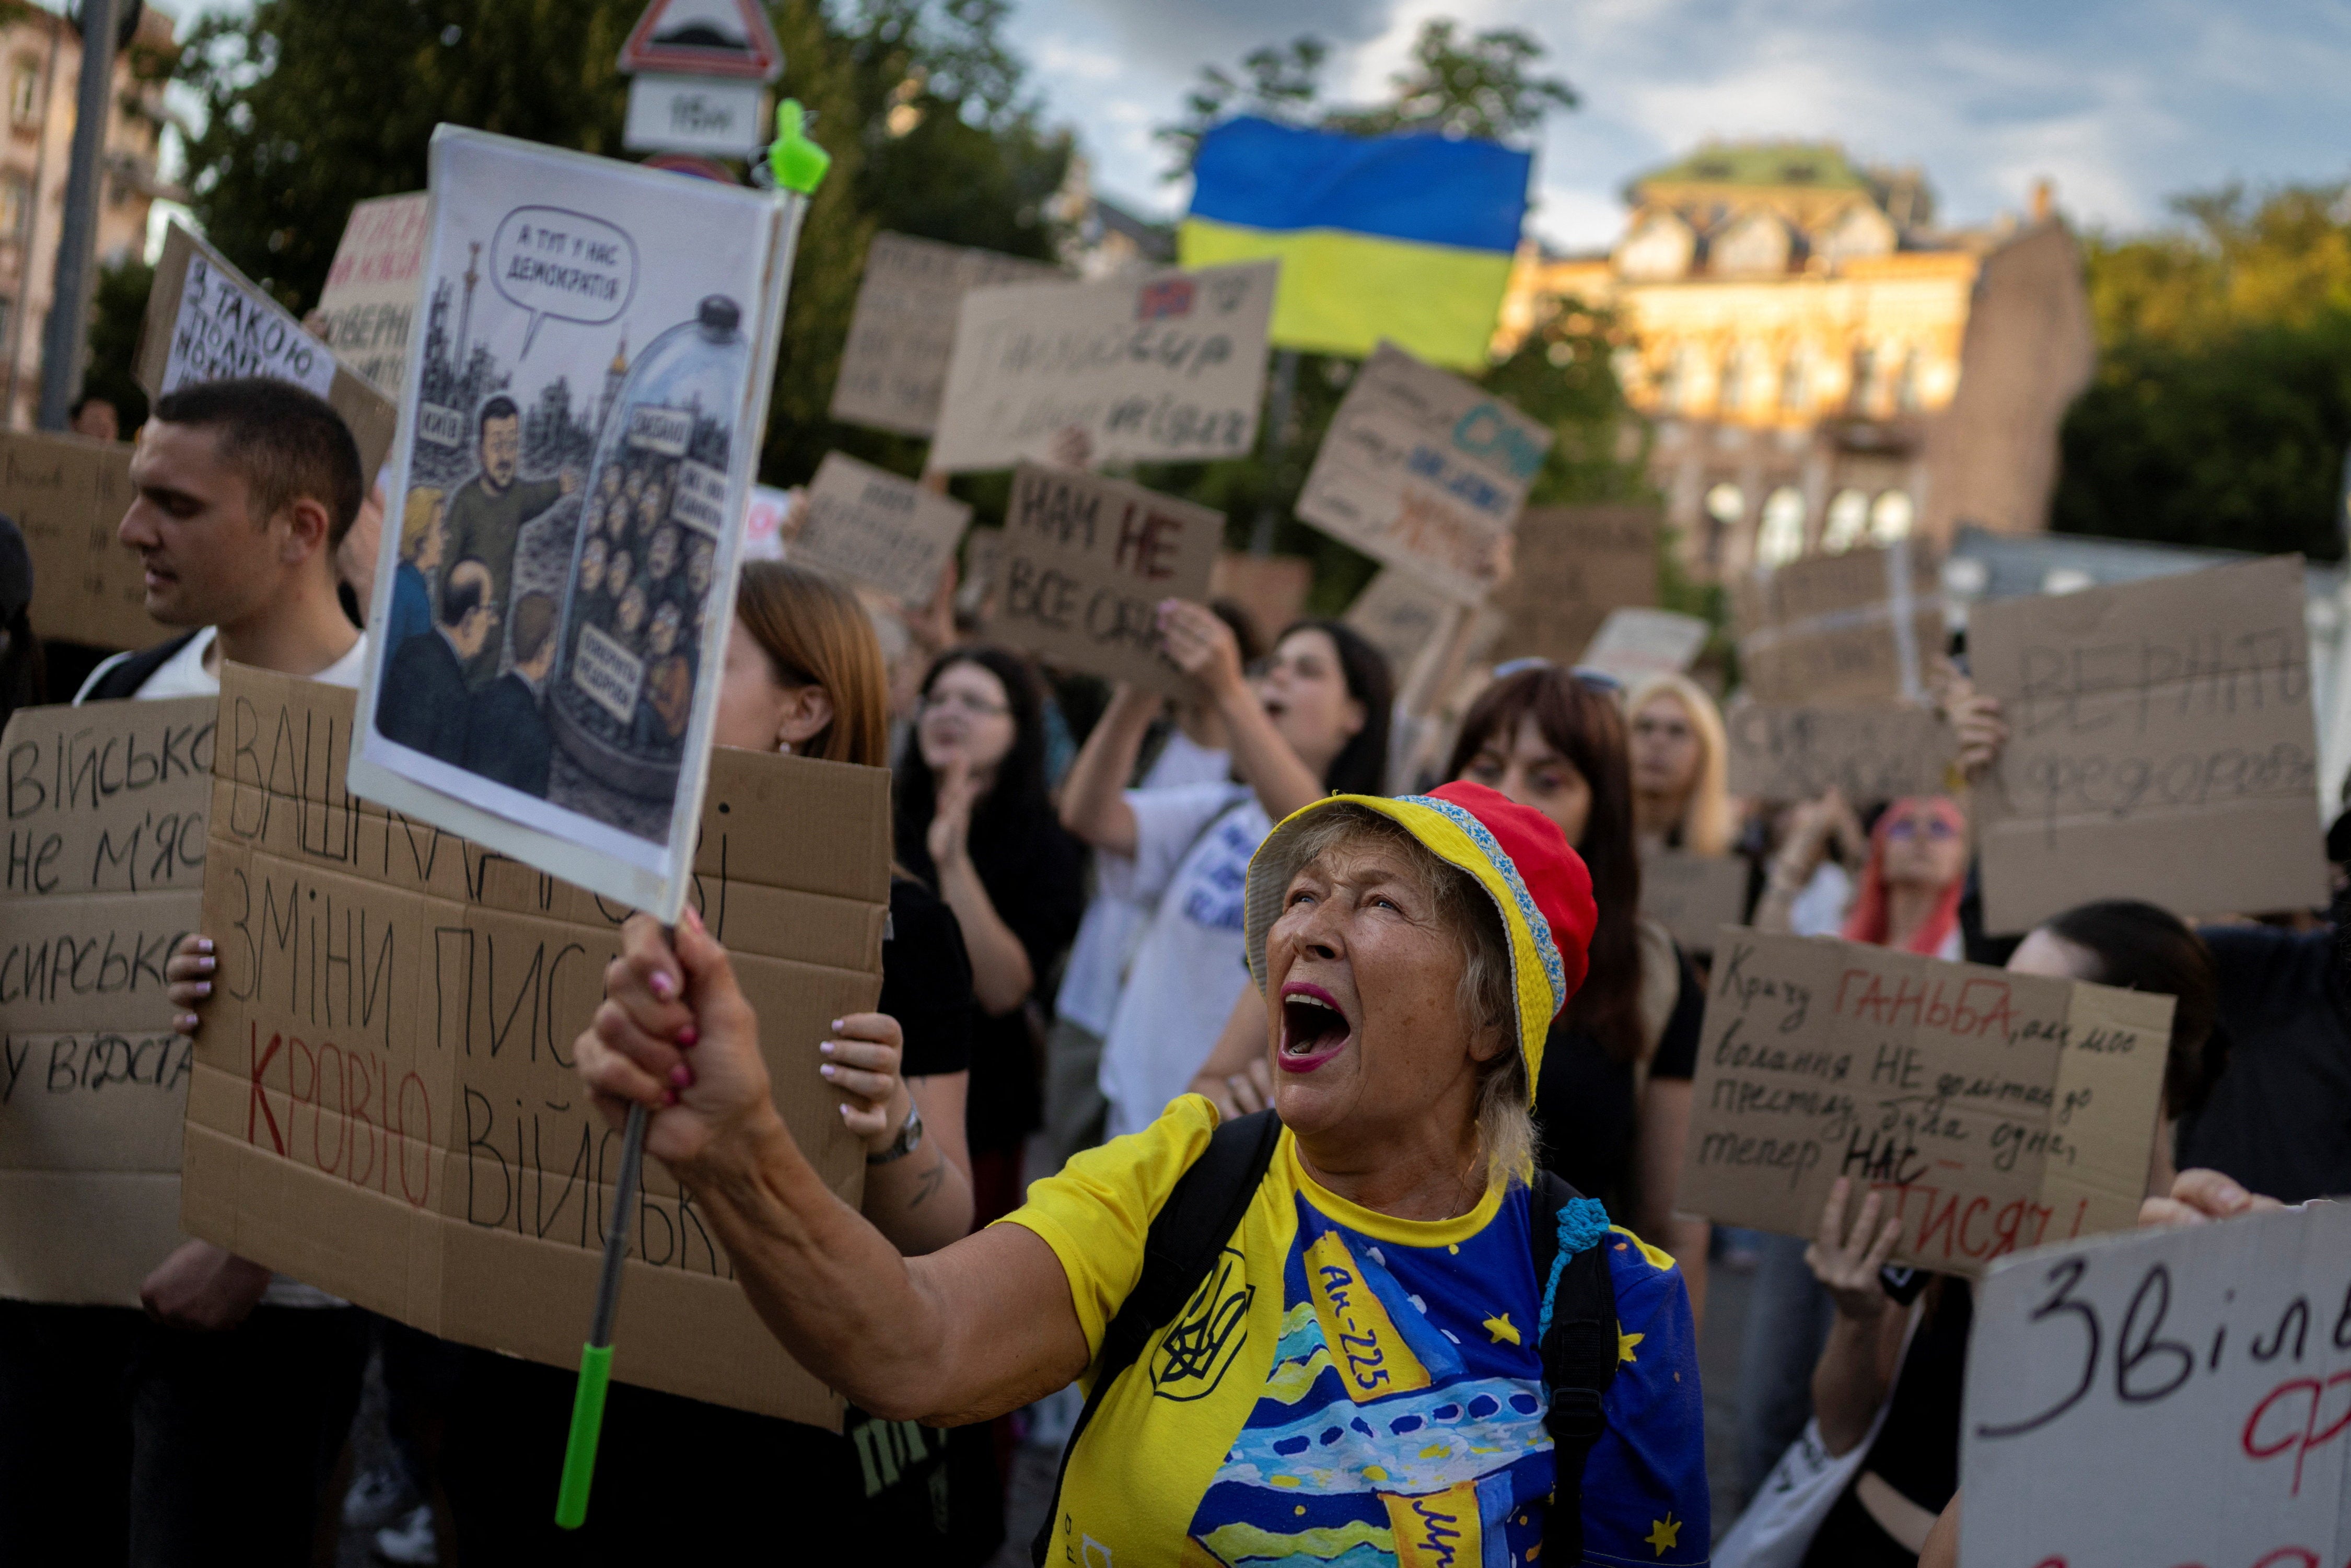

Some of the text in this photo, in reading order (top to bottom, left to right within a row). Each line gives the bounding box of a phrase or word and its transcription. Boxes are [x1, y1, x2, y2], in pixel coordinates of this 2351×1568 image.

[518, 224, 532, 245] А
[537, 228, 568, 253] ТУТ
[586, 241, 619, 265] НАС
[506, 253, 619, 301] ДЕМОКРАТІЯ
[214, 281, 315, 379] ТАКОЮ
[1114, 501, 1184, 581] НЕ
[1870, 1044, 1927, 1090] НЕ
[1839, 1125, 1930, 1186] НАС
